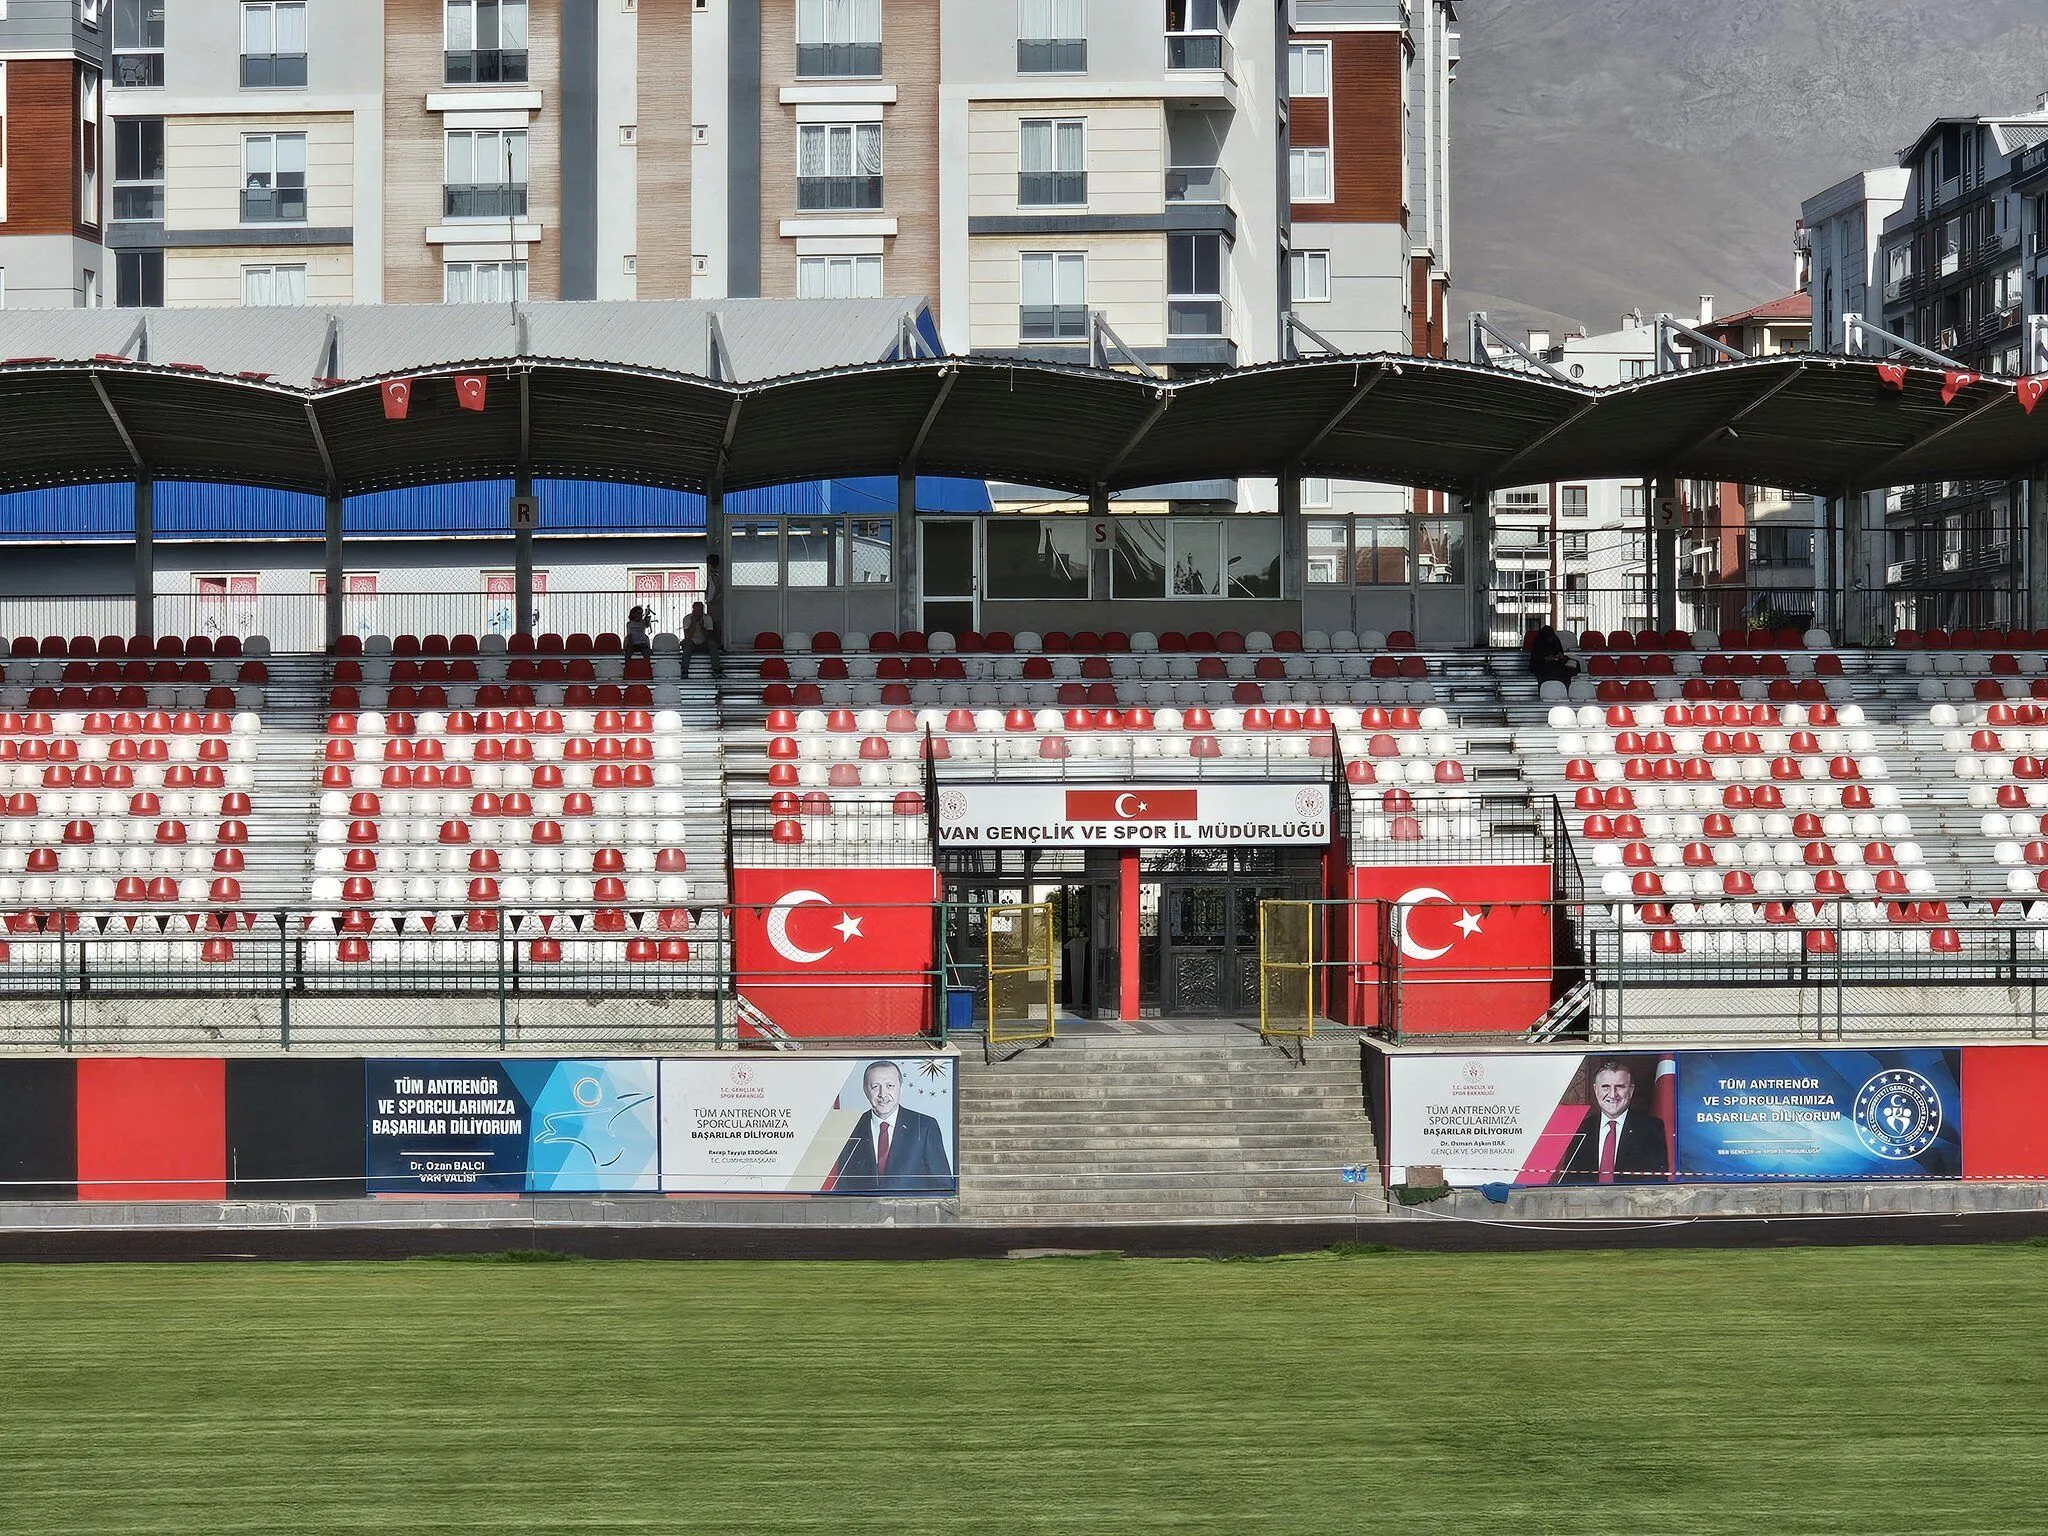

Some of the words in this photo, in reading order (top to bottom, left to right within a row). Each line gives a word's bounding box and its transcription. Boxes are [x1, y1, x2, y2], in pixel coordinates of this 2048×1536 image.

[518, 503, 530, 522] R
[1662, 502, 1673, 525] Ş
[1095, 523, 1107, 543] S
[938, 826, 979, 840] VAN
[986, 823, 1075, 844] GENÇLİK
[1081, 826, 1107, 840] VE
[1113, 826, 1167, 839] SPOR
[1174, 822, 1192, 839] İL
[1198, 822, 1326, 839] MÜDÜRLÜĞÜ
[394, 1076, 424, 1094] TÜM
[428, 1076, 498, 1094] ANTRENÖR
[1718, 1078, 1746, 1090] TÜM
[1749, 1078, 1820, 1089] ANTRENÖR
[1702, 1096, 1720, 1106] VE
[1723, 1094, 1835, 1106] SPORCULARIMIZA
[378, 1099, 395, 1114] VE
[398, 1099, 516, 1114] SPORCULARIMIZA
[693, 1107, 718, 1118] TÜM
[720, 1107, 777, 1118] ANTRENÖR
[778, 1108, 792, 1118] VE
[1425, 1104, 1449, 1115] TÜM
[1451, 1104, 1506, 1115] ANTRENÖR
[1508, 1106, 1520, 1115] VE
[1429, 1116, 1518, 1126] SPORCULARIMIZA
[1696, 1112, 1768, 1124] BAŞARILAR
[1771, 1110, 1841, 1122] DİLİYORUM
[372, 1119, 446, 1136] BAŞARILAR
[450, 1116, 522, 1134] DİLİYORUM
[696, 1119, 790, 1128] SPORCULARIMIZA
[691, 1131, 742, 1140] BAŞARILAR
[743, 1130, 795, 1139] DİLİYORUM
[1423, 1128, 1472, 1136] BAŞARILAR
[1473, 1126, 1523, 1136] DİLİYORUM
[410, 1161, 424, 1170] Dr.
[426, 1161, 452, 1170] Ozan
[454, 1161, 485, 1170] BALCI
